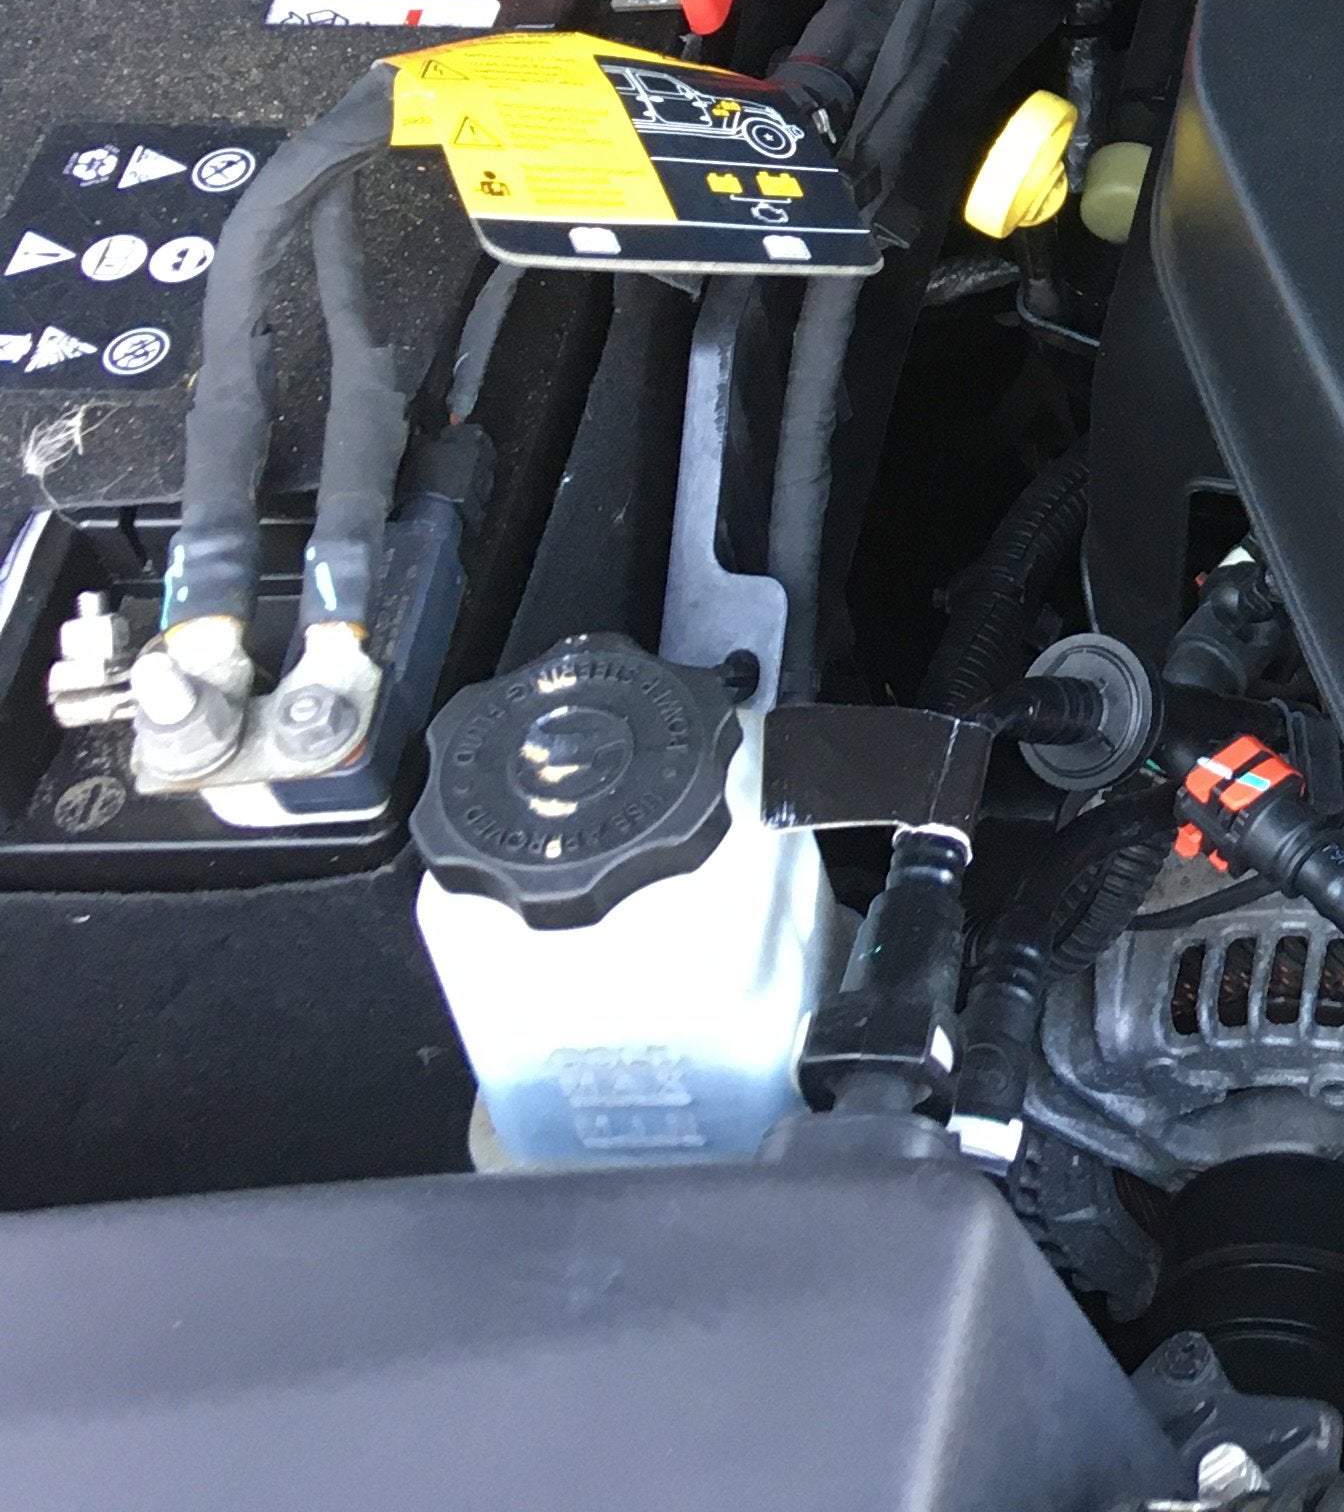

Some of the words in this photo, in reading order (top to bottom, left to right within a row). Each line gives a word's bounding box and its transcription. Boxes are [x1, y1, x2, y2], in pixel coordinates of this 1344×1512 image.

[506, 660, 638, 703] STEERING
[453, 705, 507, 764] FLUID
[641, 680, 689, 752] POWER
[464, 805, 610, 858] APPROVED
[612, 792, 662, 834] USE
